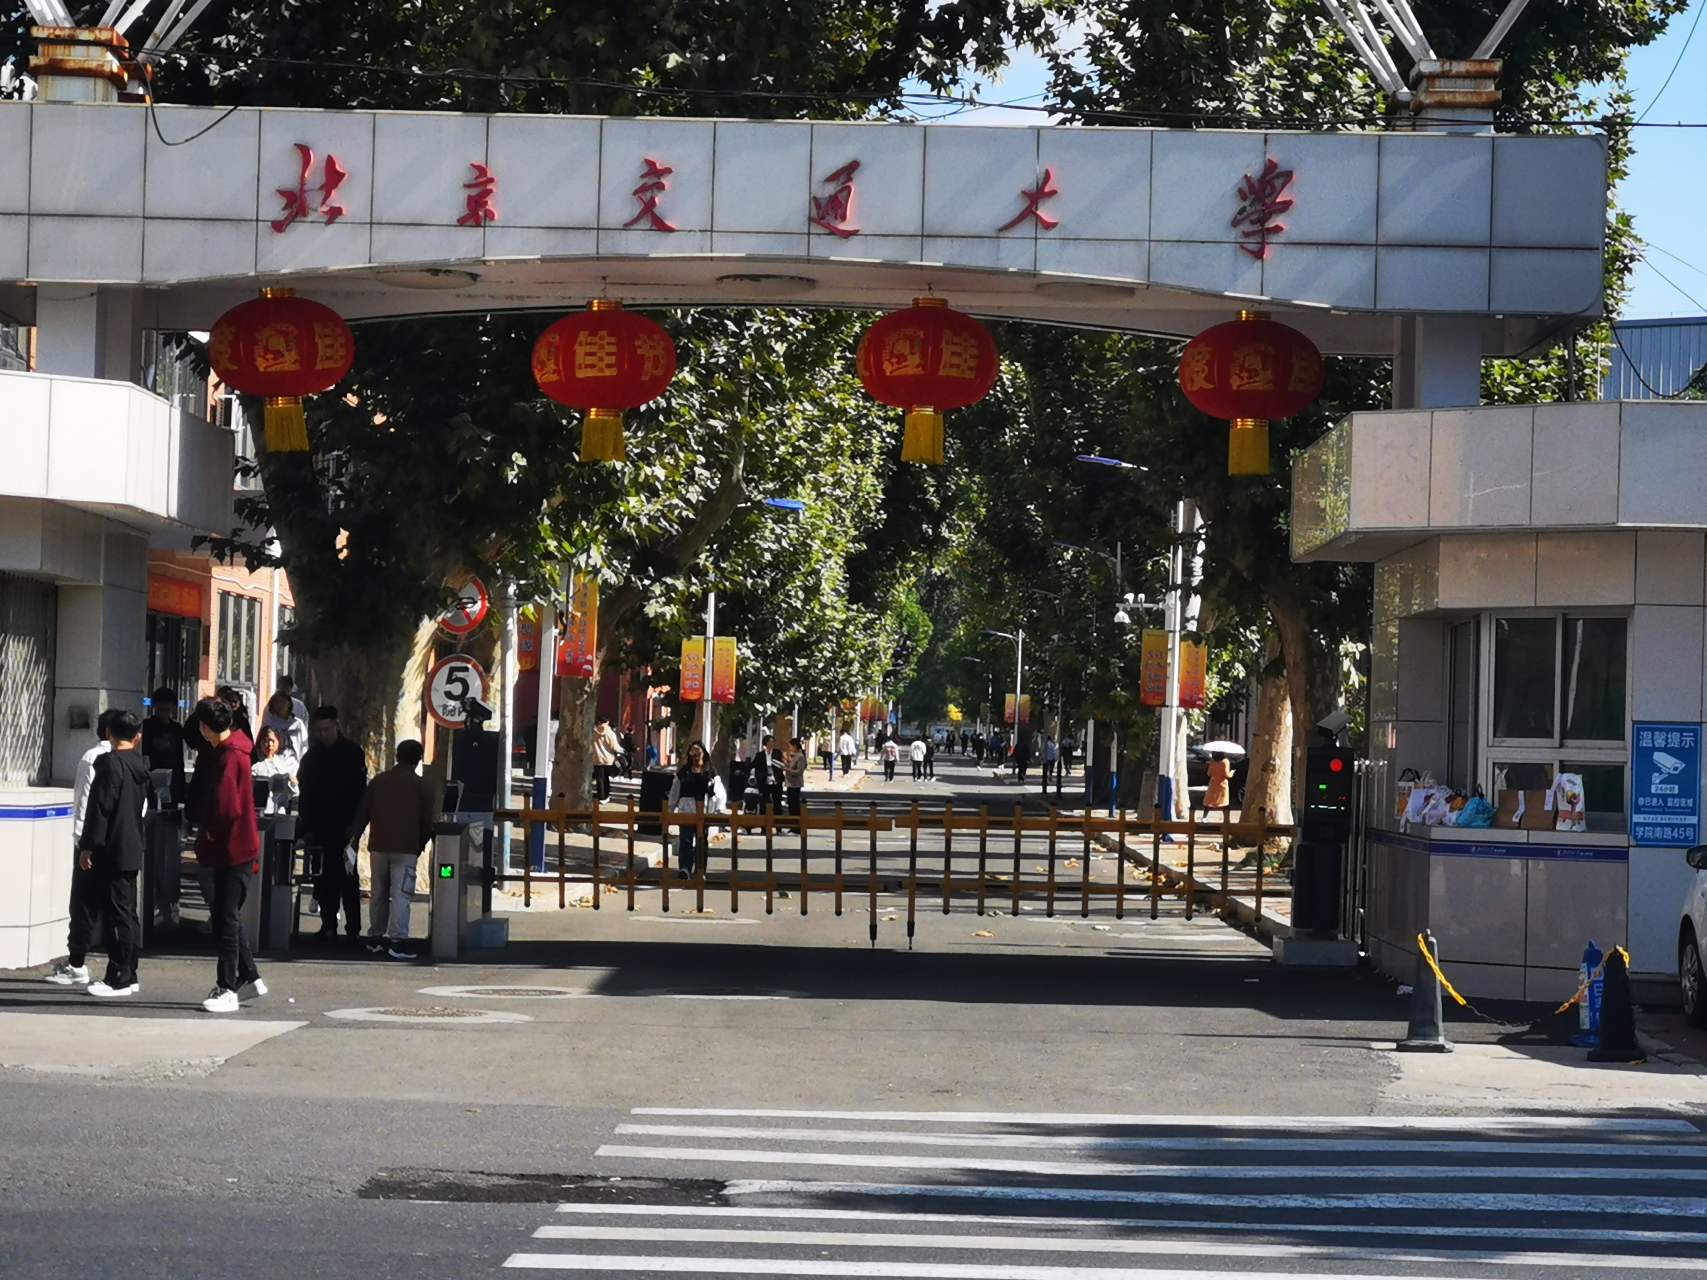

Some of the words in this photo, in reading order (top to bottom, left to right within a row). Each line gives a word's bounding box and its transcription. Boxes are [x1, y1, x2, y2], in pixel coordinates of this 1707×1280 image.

[443, 665, 470, 702] 5
[1639, 731, 1695, 748] 温馨提示
[1653, 785, 1676, 793] 24小时
[1635, 825, 1695, 840] 学院南路45号
